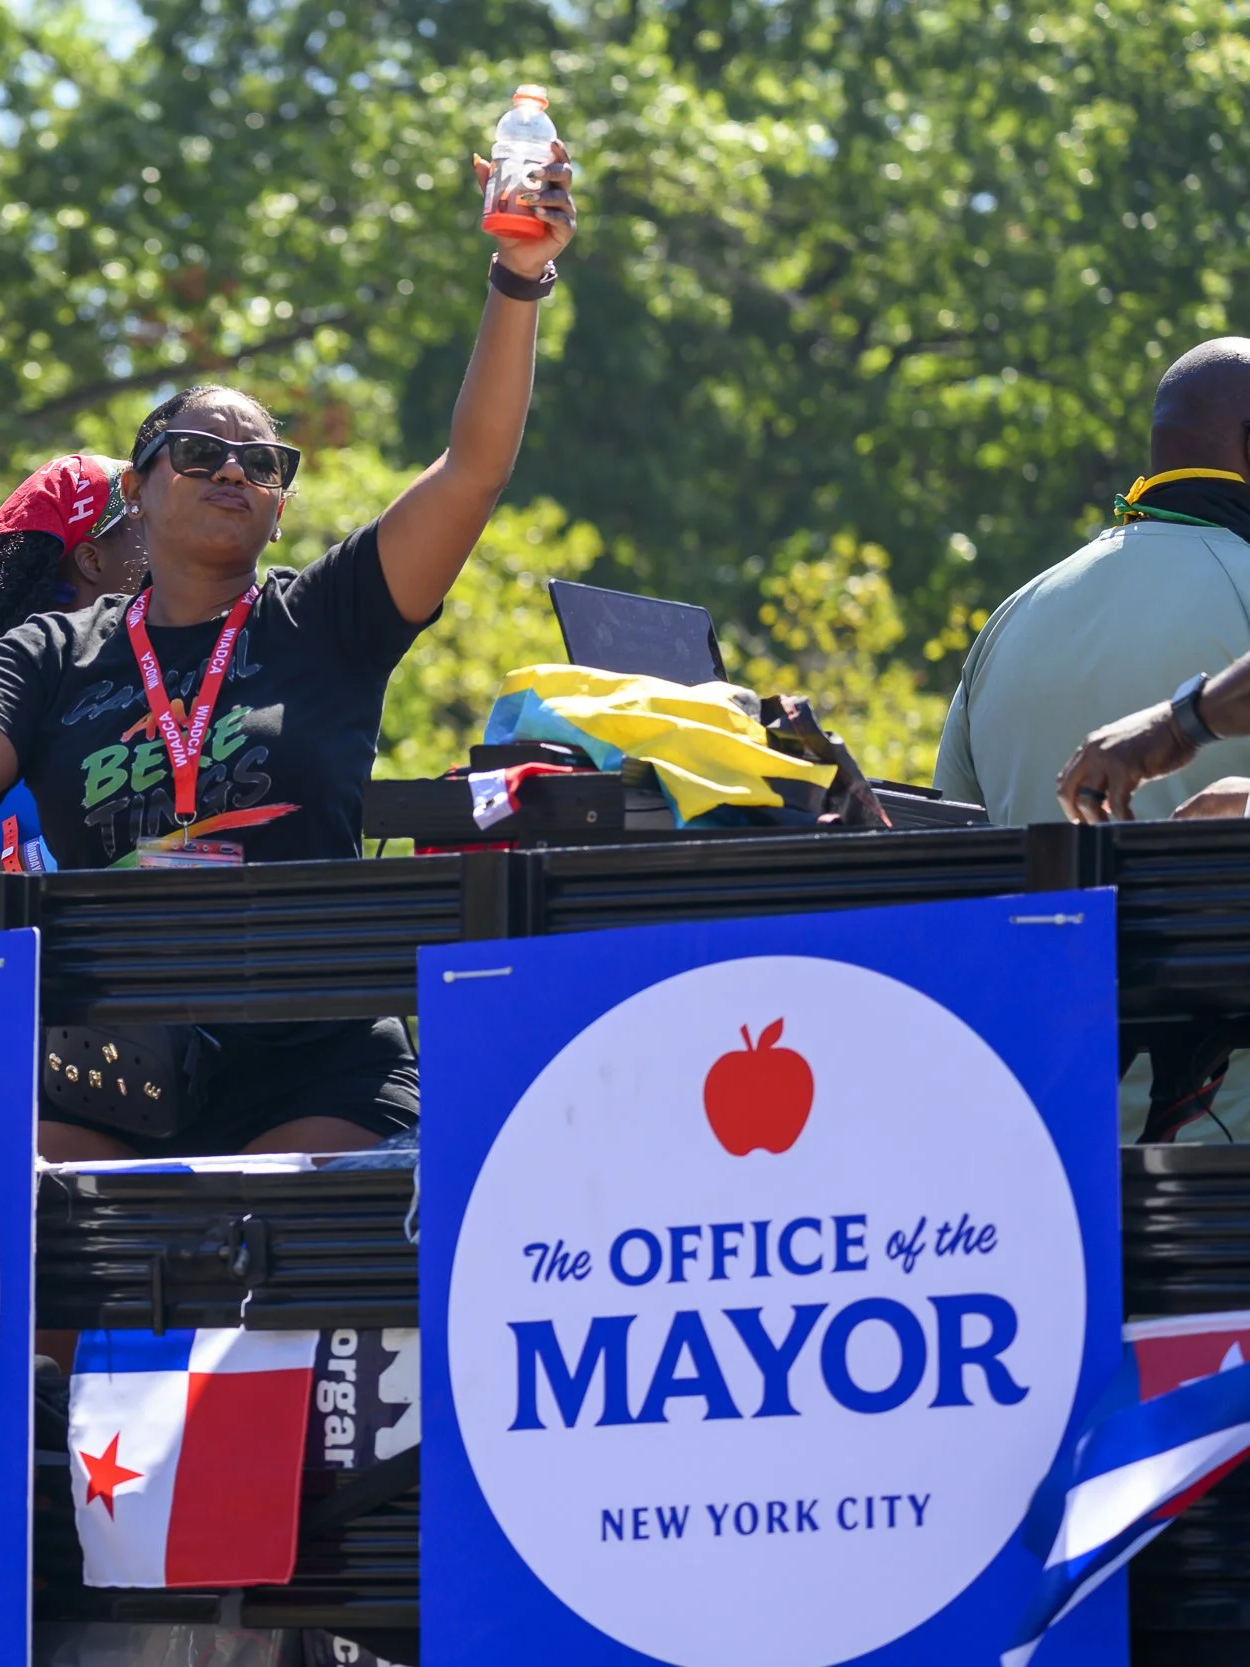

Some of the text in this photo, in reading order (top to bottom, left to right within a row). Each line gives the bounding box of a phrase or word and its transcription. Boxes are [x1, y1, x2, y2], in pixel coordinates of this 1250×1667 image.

[186, 627, 237, 756] WIADCA WIADCA
[158, 711, 188, 768] WIADCA
[523, 1212, 998, 1287] The OFFICE of the
[506, 1292, 1031, 1432] MAYOR
[601, 1493, 931, 1542] NEW YORK CITY
